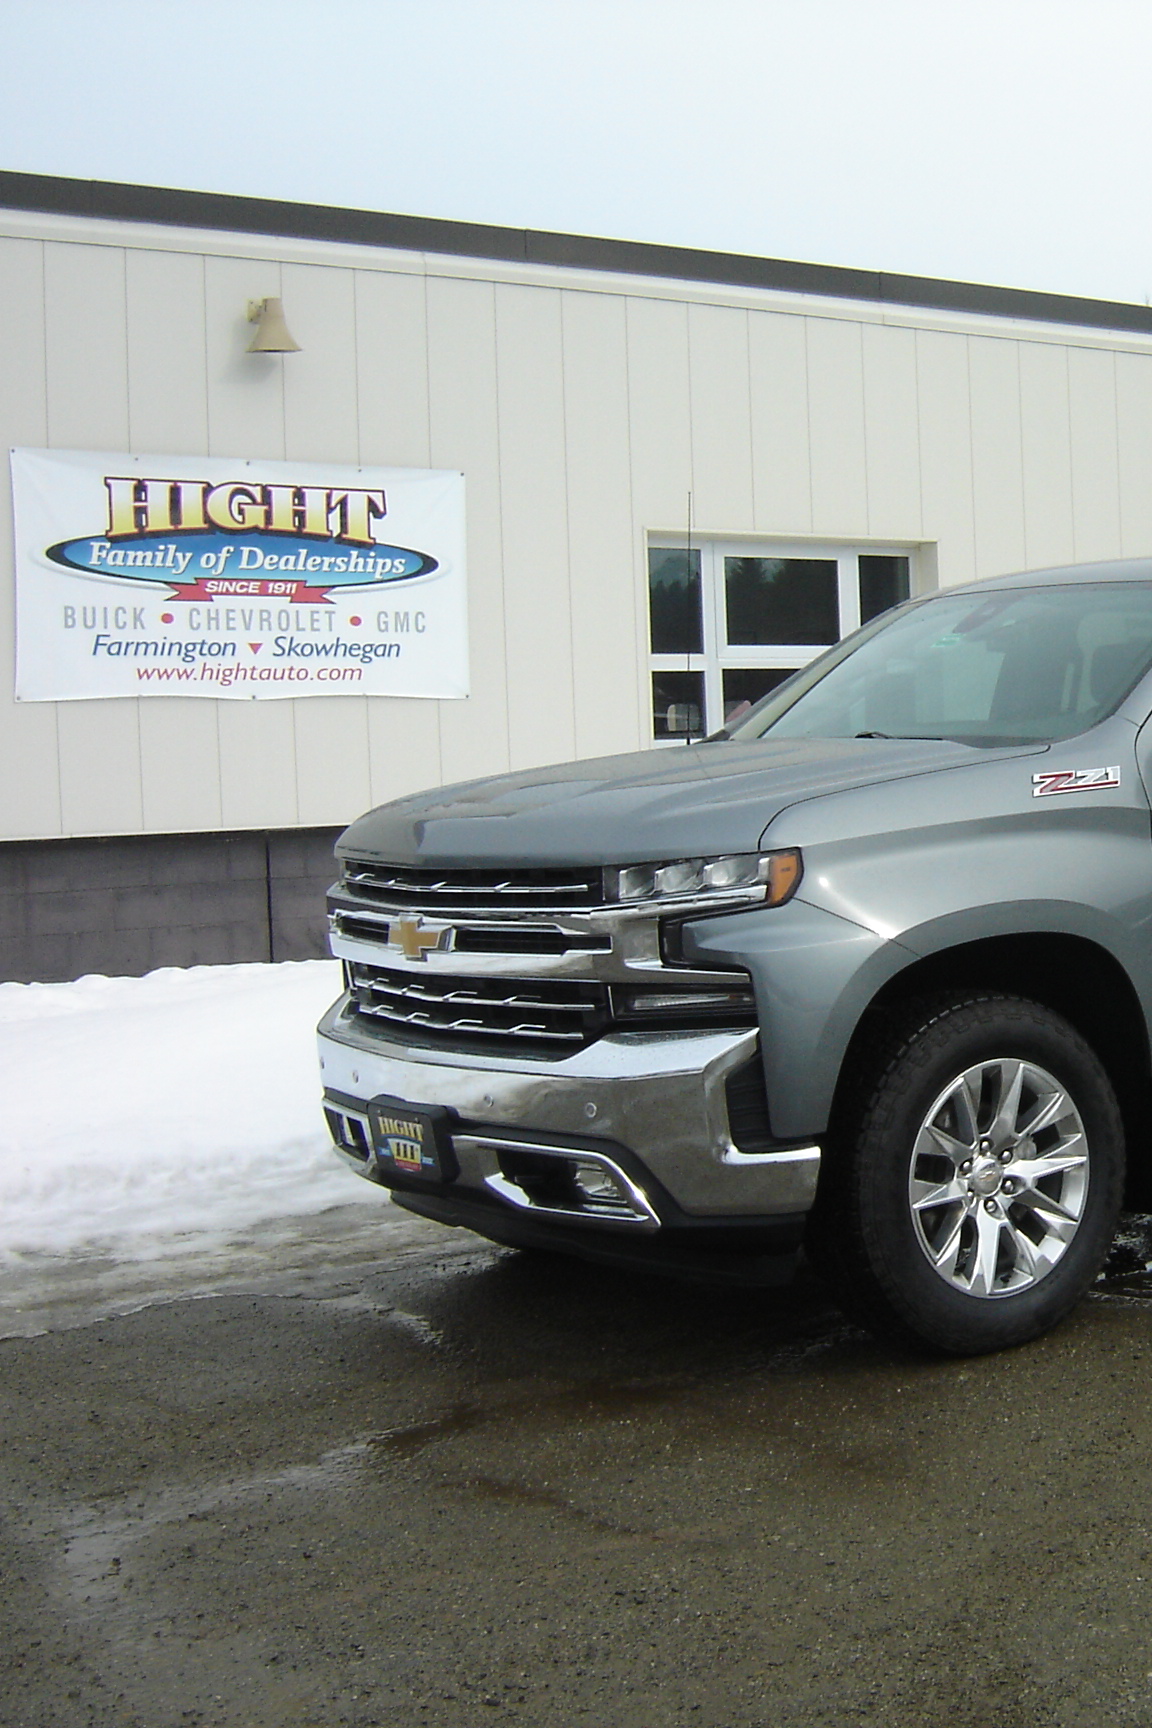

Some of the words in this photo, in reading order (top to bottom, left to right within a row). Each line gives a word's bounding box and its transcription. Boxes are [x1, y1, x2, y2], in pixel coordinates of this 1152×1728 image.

[104, 476, 387, 547] HIGHT
[89, 541, 192, 575] Family
[200, 546, 234, 576] of
[238, 546, 406, 580] Dealerships
[204, 581, 260, 594] SINCE
[267, 582, 298, 595] 1911
[63, 605, 147, 631] BUICK
[188, 607, 337, 633] CHEVROLET
[376, 610, 427, 634] GMC
[91, 634, 237, 663] Farmington
[272, 635, 402, 664] Skowhegan
[136, 662, 363, 687] www.hightauto.com
